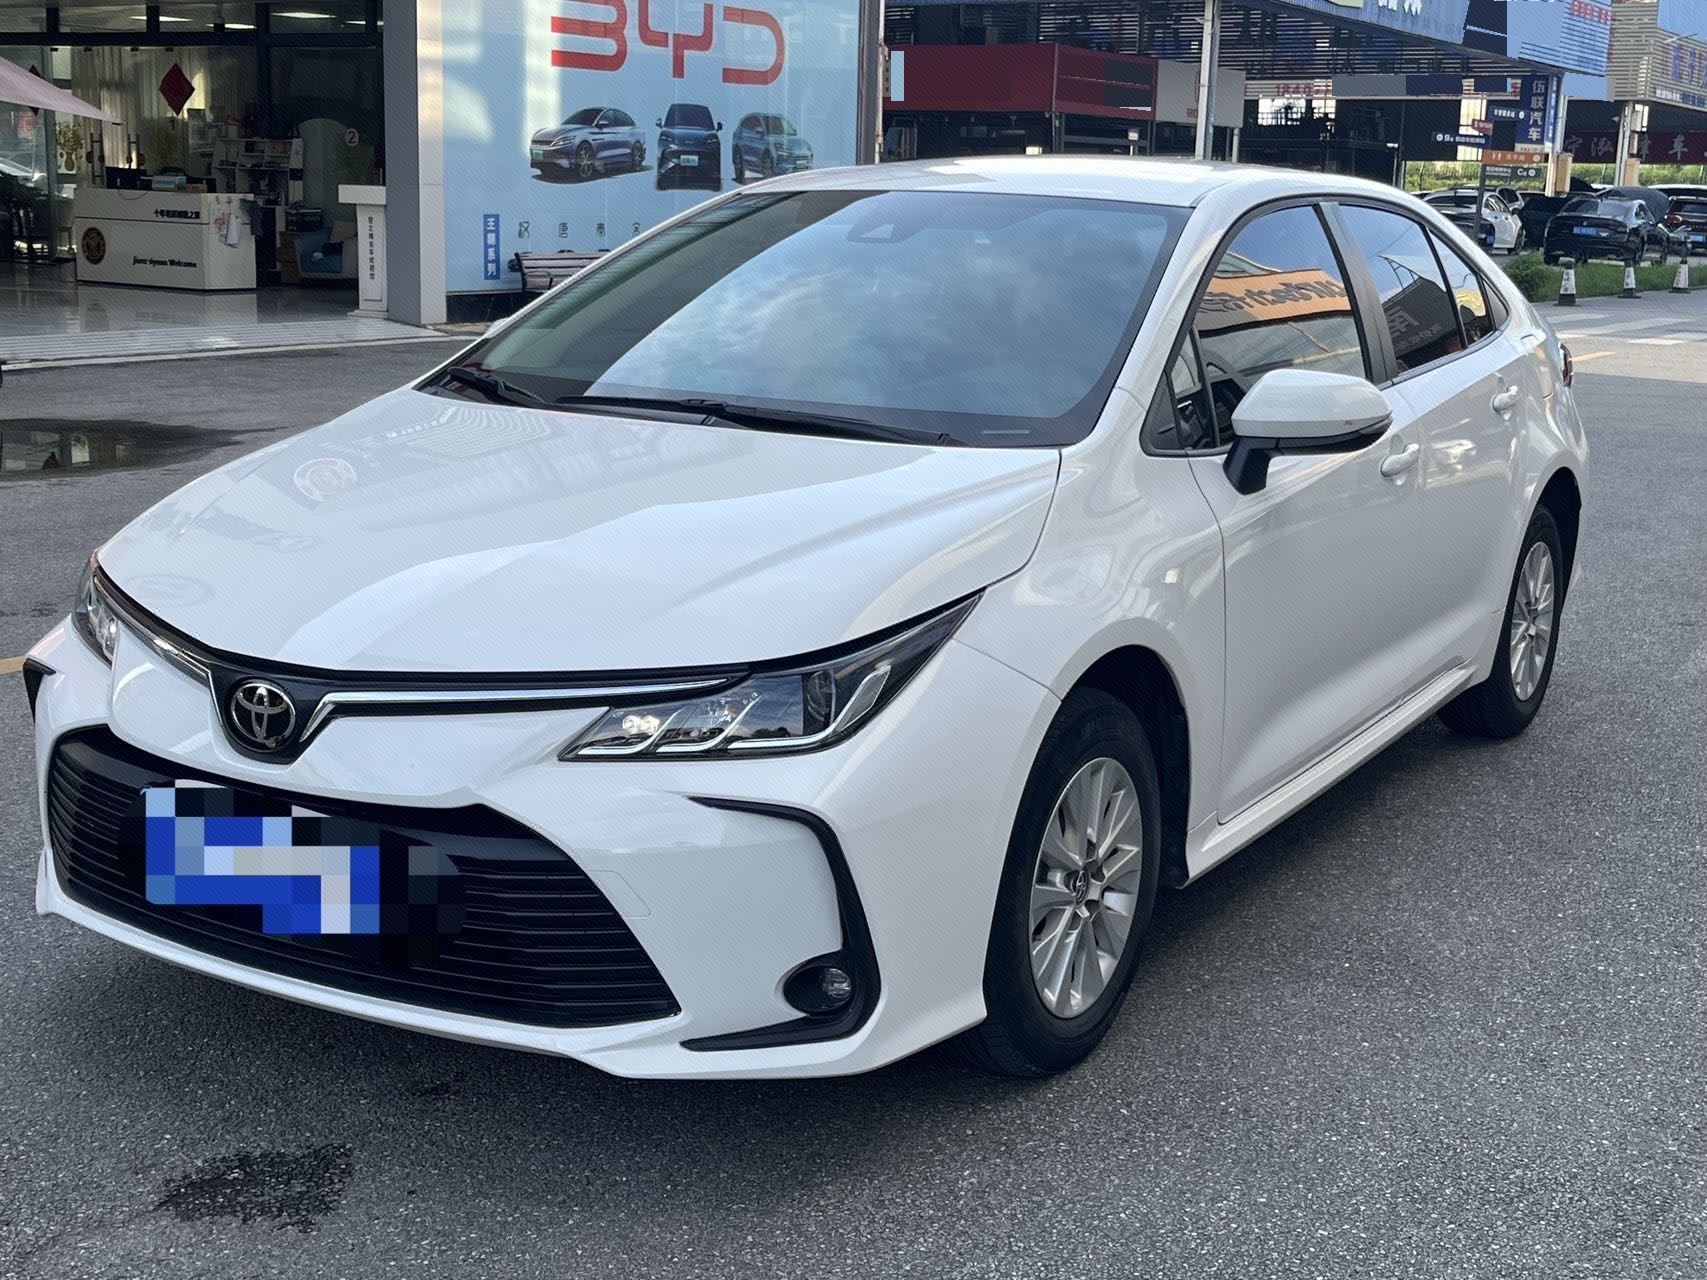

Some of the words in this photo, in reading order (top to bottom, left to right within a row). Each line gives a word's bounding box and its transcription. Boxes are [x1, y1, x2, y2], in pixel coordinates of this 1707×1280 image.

[551, 0, 785, 85] BYD
[1528, 80, 1545, 142] 伍联汽车
[486, 217, 497, 276] 王朝系列
